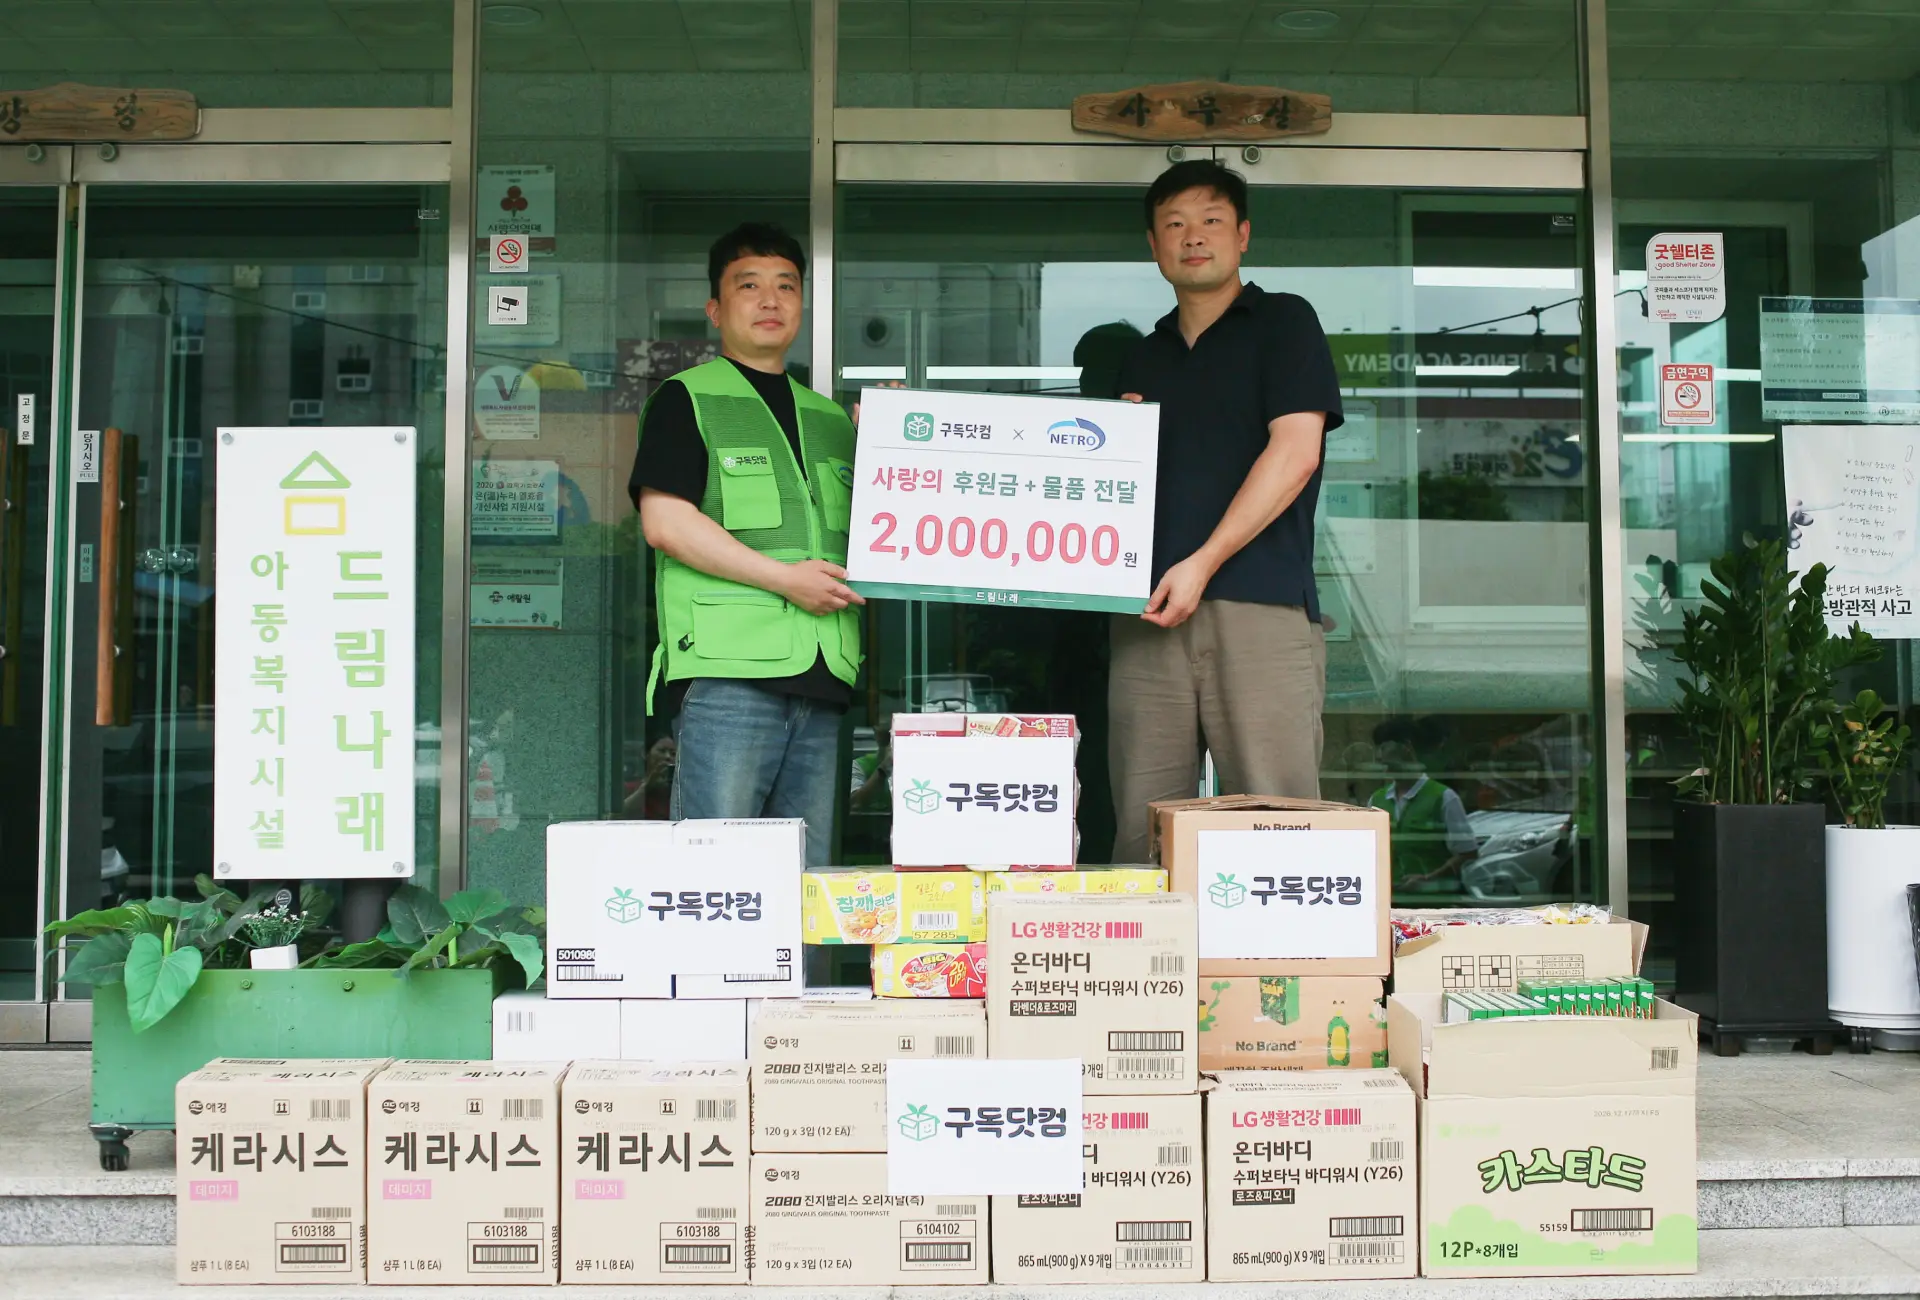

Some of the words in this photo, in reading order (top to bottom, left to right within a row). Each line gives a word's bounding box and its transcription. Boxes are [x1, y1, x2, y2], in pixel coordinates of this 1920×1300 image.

[1654, 244, 1715, 260] 굿쉘터존
[1666, 367, 1709, 379] 금연구역
[22, 397, 31, 440] 고정문
[940, 422, 992, 440] 구독닷컴
[1050, 432, 1096, 447] NETRO
[83, 433, 94, 470] 당기시오
[735, 455, 767, 465] 구독닷컴
[872, 466, 943, 493] 사랑의
[953, 470, 1019, 497] 후원금
[1042, 476, 1086, 500] 물품
[1094, 478, 1138, 504] 전달
[511, 502, 545, 512] 지원시설
[869, 511, 1119, 568] 2,000,000
[1123, 552, 1137, 568] 원
[975, 590, 1019, 604] 드림나래
[1821, 599, 1876, 616] 방관적
[1881, 599, 1912, 616] 사고
[249, 551, 289, 849] 아동복지시설
[332, 550, 392, 851] 드림나래
[945, 782, 1058, 812] 구독닷컴
[1253, 823, 1271, 831] No
[1273, 823, 1311, 831] Brand
[1251, 876, 1361, 906] 구독닷컴
[648, 891, 762, 921] 구독닷컴
[836, 893, 895, 913] 참깨라면
[1010, 952, 1091, 974] 온더바디
[1010, 980, 1079, 997] 수퍼보타닉
[1084, 980, 1139, 996] 바디워시
[1143, 980, 1184, 996] (Y26)
[1012, 1001, 1076, 1015] 라벤더&로즈마리
[779, 1037, 799, 1048] 애경
[1235, 1041, 1254, 1051] No
[1256, 1041, 1297, 1051] Brand
[764, 1064, 800, 1074] 2080
[803, 1062, 857, 1074] 진지발리스
[1087, 1063, 1104, 1079] 개입
[205, 1102, 227, 1113] 애경
[398, 1101, 420, 1112] 애경
[592, 1101, 613, 1112] 애경
[944, 1107, 1067, 1138] 구독닷컴
[765, 1126, 781, 1137] 120
[784, 1129, 791, 1139] g
[800, 1125, 815, 1137] 3입
[817, 1126, 832, 1138] (12
[834, 1126, 851, 1138] EA)
[191, 1132, 348, 1172] 케라시스
[384, 1131, 541, 1172] 케라시스
[577, 1132, 734, 1172] 케라시스
[1233, 1140, 1312, 1163] 온더바디
[780, 1170, 800, 1181] 애경
[1233, 1168, 1300, 1185] 수퍼보타닉
[1305, 1167, 1359, 1183] 바디워시
[1364, 1165, 1404, 1182] (Y26)
[1477, 1146, 1646, 1193] 카스타드
[1091, 1171, 1146, 1187] 바디워시
[1151, 1171, 1191, 1187] (Y26)
[195, 1184, 232, 1196] 데미지
[388, 1183, 426, 1195] 데미지
[581, 1183, 618, 1195] 데미지
[765, 1196, 801, 1207] 2080
[804, 1194, 858, 1207] 진지발리스
[1235, 1190, 1292, 1203] 로즈&피오니
[291, 1225, 336, 1237] 6103188
[484, 1225, 528, 1237] 6103188
[676, 1225, 720, 1237] 6103188
[917, 1223, 960, 1235] 6104102
[1540, 1223, 1568, 1231] 55159
[1018, 1255, 1035, 1267] 865
[1080, 1255, 1087, 1266] X
[1088, 1255, 1095, 1266] 9
[1096, 1254, 1112, 1268] 개입
[1233, 1252, 1249, 1264] 865
[1294, 1251, 1300, 1262] X
[1302, 1251, 1308, 1262] 9
[1309, 1249, 1325, 1264] 개입
[190, 1260, 207, 1271] 샴푸
[234, 1259, 249, 1271] EA)
[383, 1260, 400, 1271] 샴푸
[427, 1259, 442, 1271] EA)
[575, 1260, 592, 1271] 샴푸
[619, 1259, 634, 1271] EA)
[766, 1259, 782, 1271] 120
[785, 1262, 792, 1273] g
[793, 1262, 799, 1270] x
[801, 1259, 816, 1271] 3입
[818, 1259, 833, 1272] (12
[835, 1259, 852, 1272] EA)
